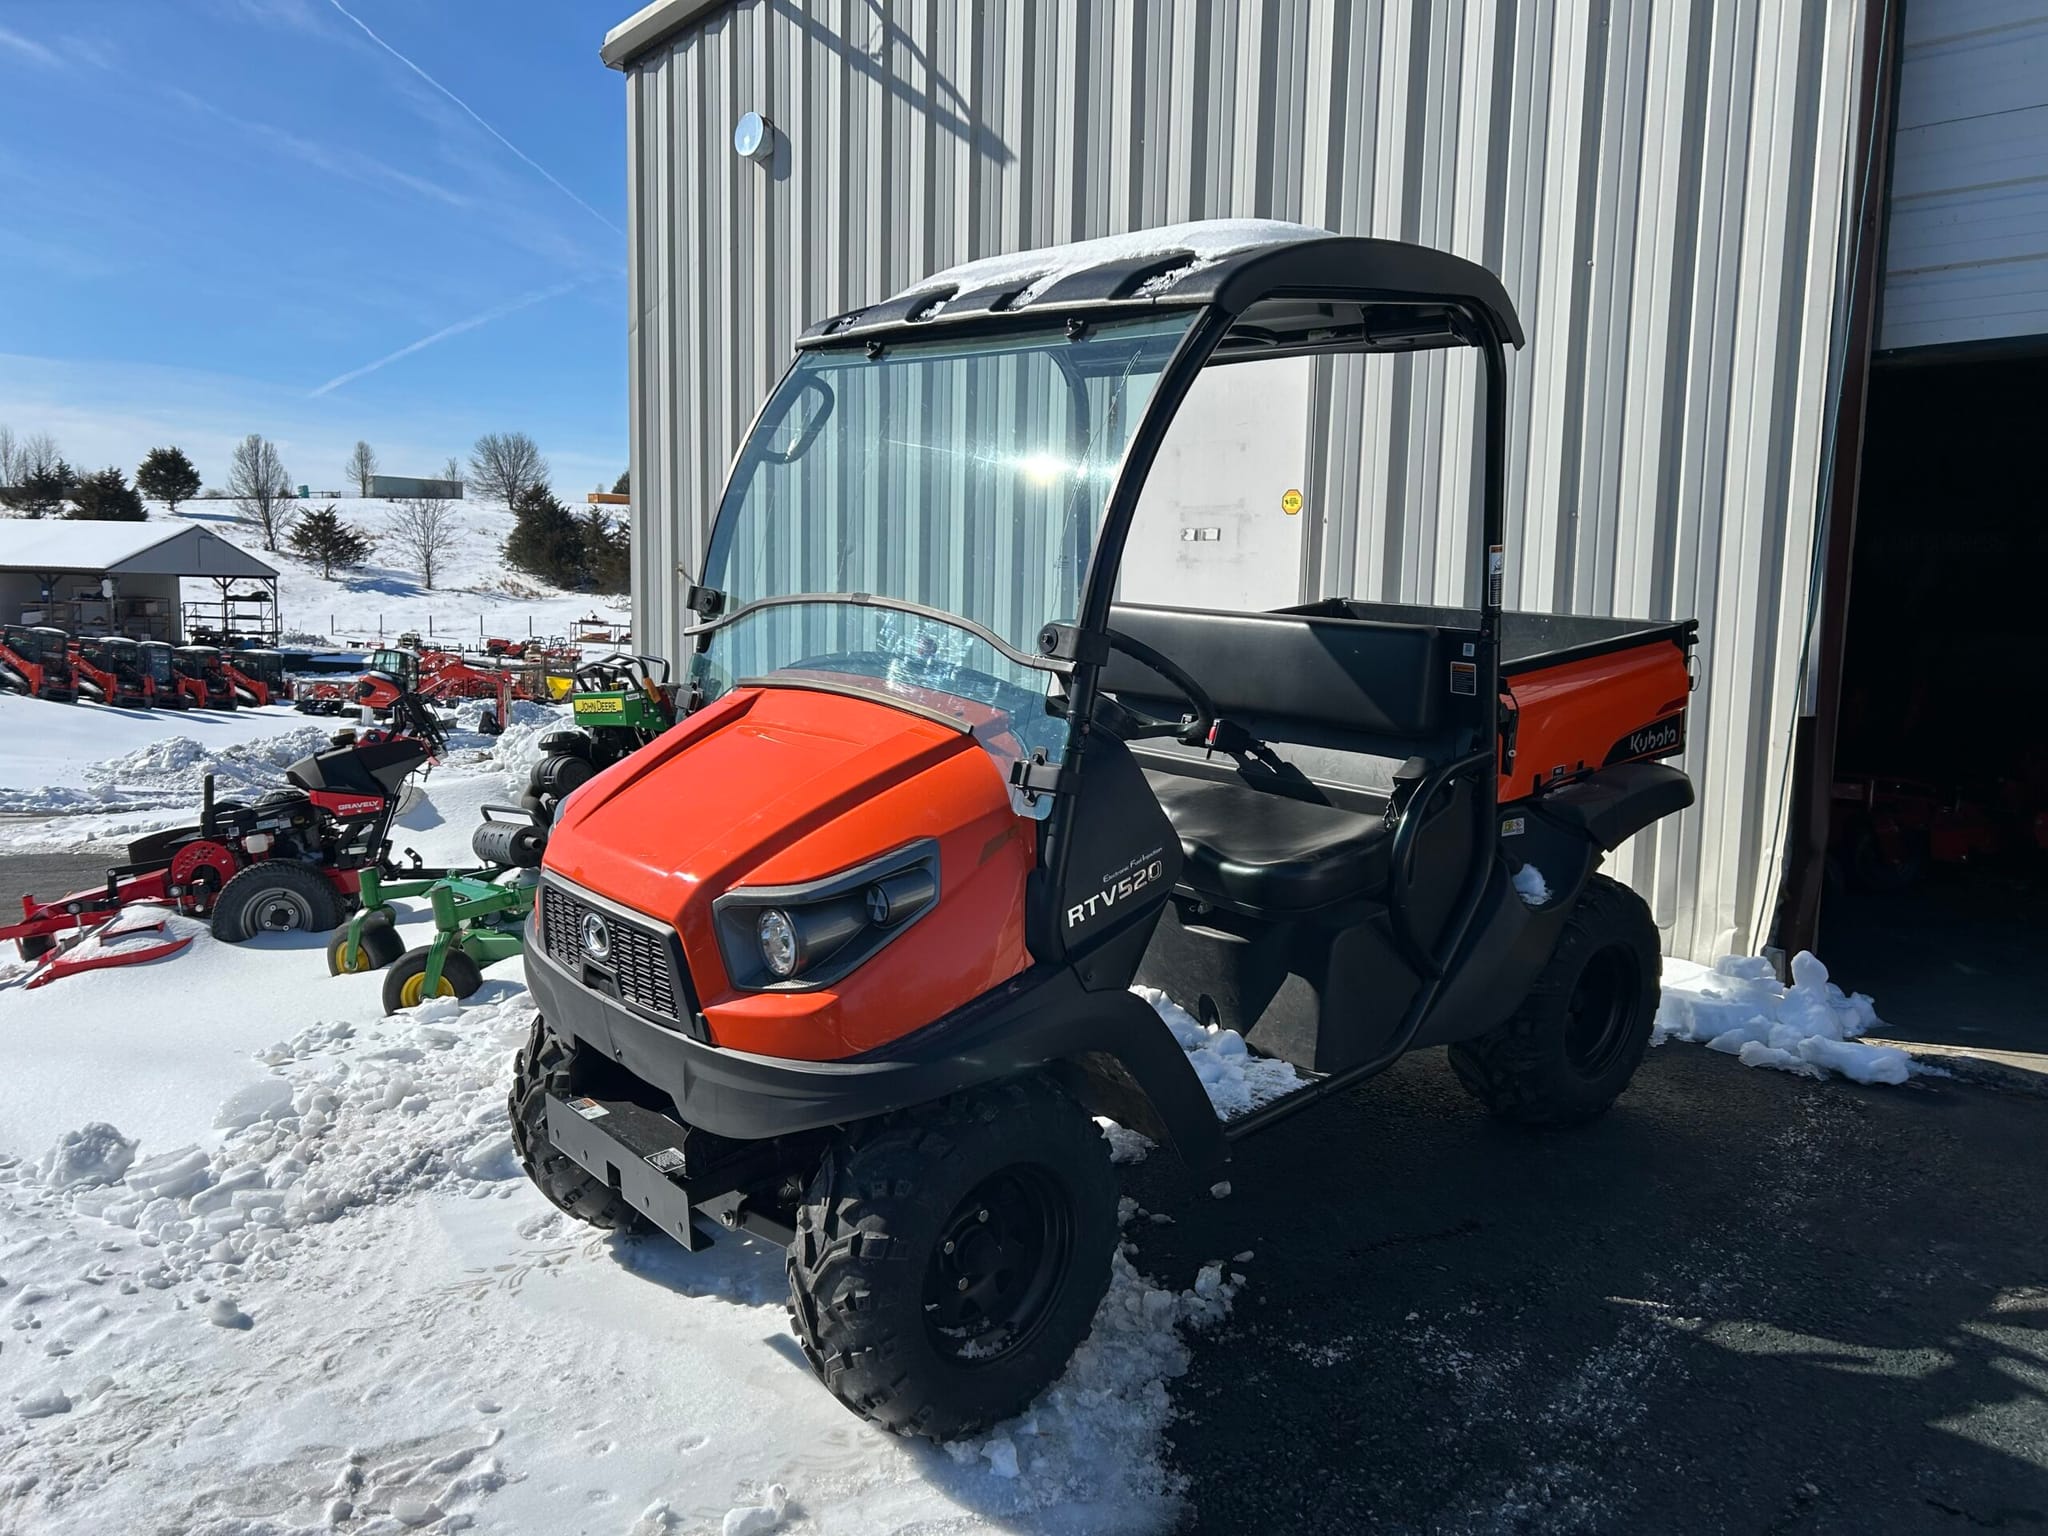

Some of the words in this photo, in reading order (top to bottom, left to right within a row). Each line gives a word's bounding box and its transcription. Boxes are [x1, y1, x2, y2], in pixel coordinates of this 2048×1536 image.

[581, 701, 596, 712] JOHN
[596, 700, 617, 711] DEERE
[1630, 725, 1676, 753] Kubota
[338, 800, 379, 811] GRAVELY
[1067, 860, 1162, 928] RTV520
